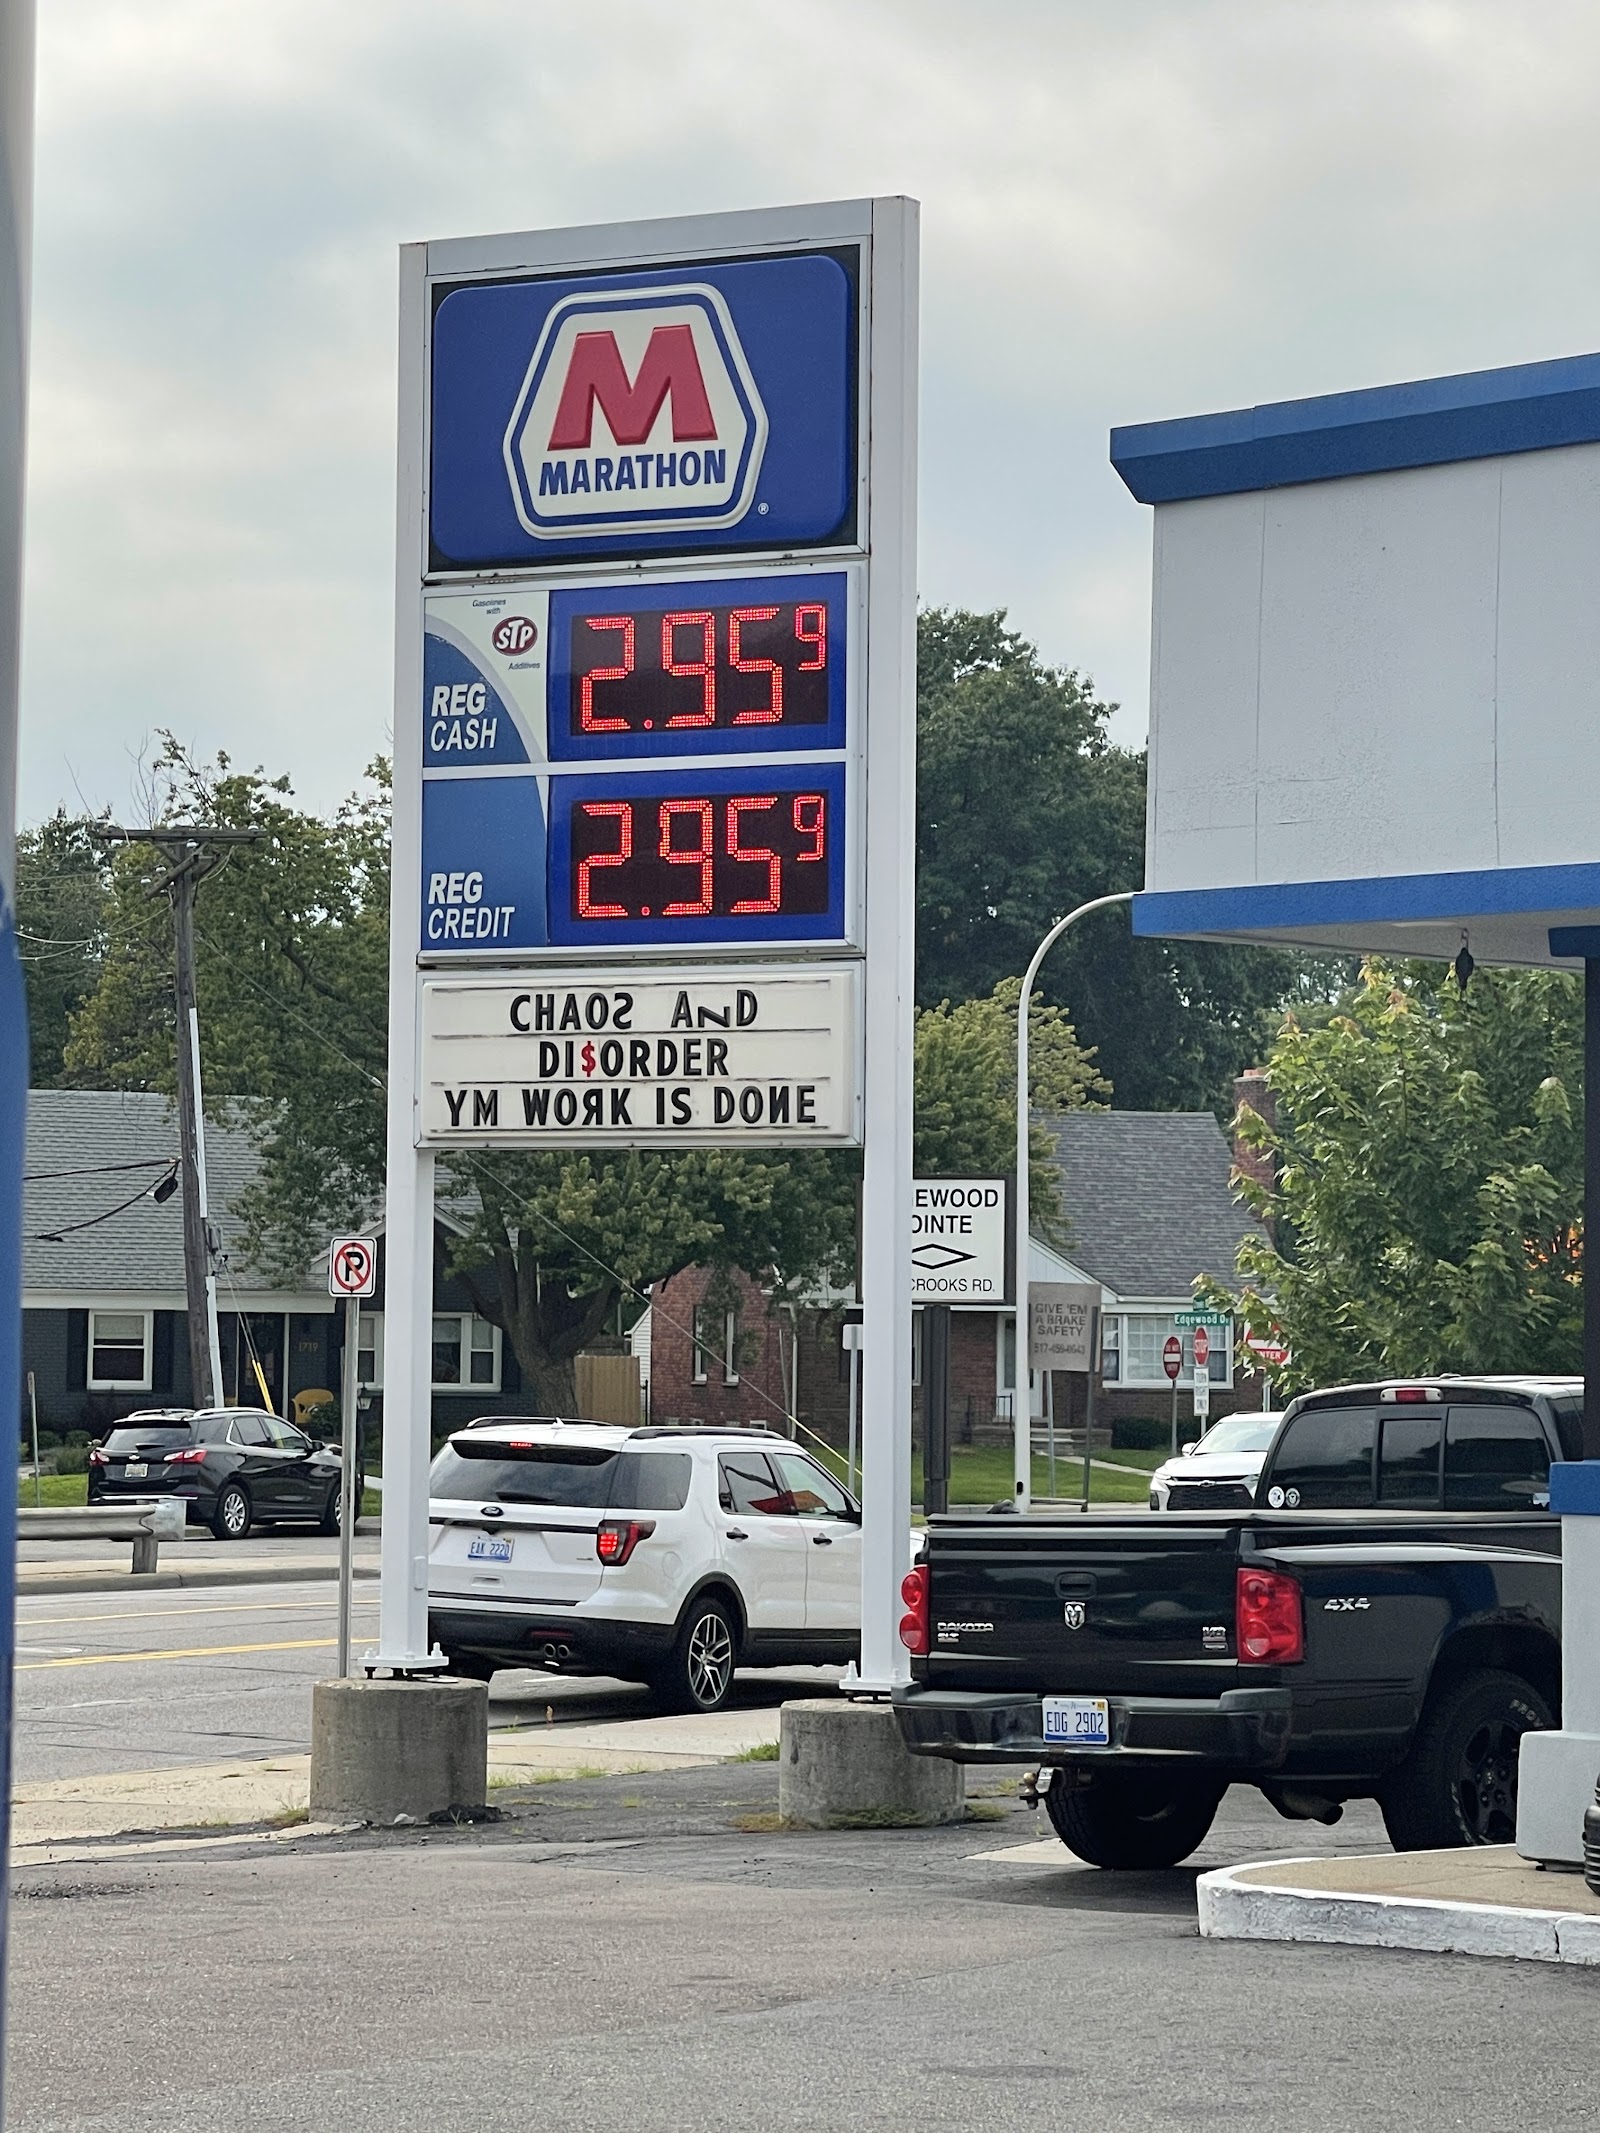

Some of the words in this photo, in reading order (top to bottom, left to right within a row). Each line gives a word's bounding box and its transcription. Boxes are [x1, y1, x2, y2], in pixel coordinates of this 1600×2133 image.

[547, 323, 718, 451] M
[539, 448, 726, 497] MARATHON
[472, 599, 506, 607] Gasolines
[496, 619, 534, 649] STP
[508, 662, 541, 670] Additives
[431, 683, 486, 717] REG
[430, 718, 498, 751] CASH
[428, 871, 483, 904] REG
[427, 906, 515, 939] CREDIT
[510, 992, 634, 1032] CHAOS
[539, 1038, 729, 1079] DI$ORDER
[444, 1088, 499, 1127] YM
[522, 1086, 634, 1127] WORK
[655, 1086, 692, 1125] IS
[912, 1188, 999, 1208] EWOOD
[911, 1214, 972, 1234] OINTE
[972, 1278, 996, 1292] RD.
[1035, 1303, 1063, 1314] GIVE
[1066, 1304, 1088, 1315] 'EM
[1035, 1315, 1044, 1324] A
[1047, 1315, 1087, 1326] BRAKE
[1174, 1314, 1218, 1326] Edgewood
[1037, 1325, 1083, 1336] SAFETY
[1194, 1338, 1208, 1354] STOP
[470, 1541, 486, 1555] EAK
[489, 1543, 510, 1557] 2220
[937, 1622, 994, 1632] DAKOTA
[1046, 1711, 1068, 1733] EDG
[1075, 1712, 1104, 1734] 2902
